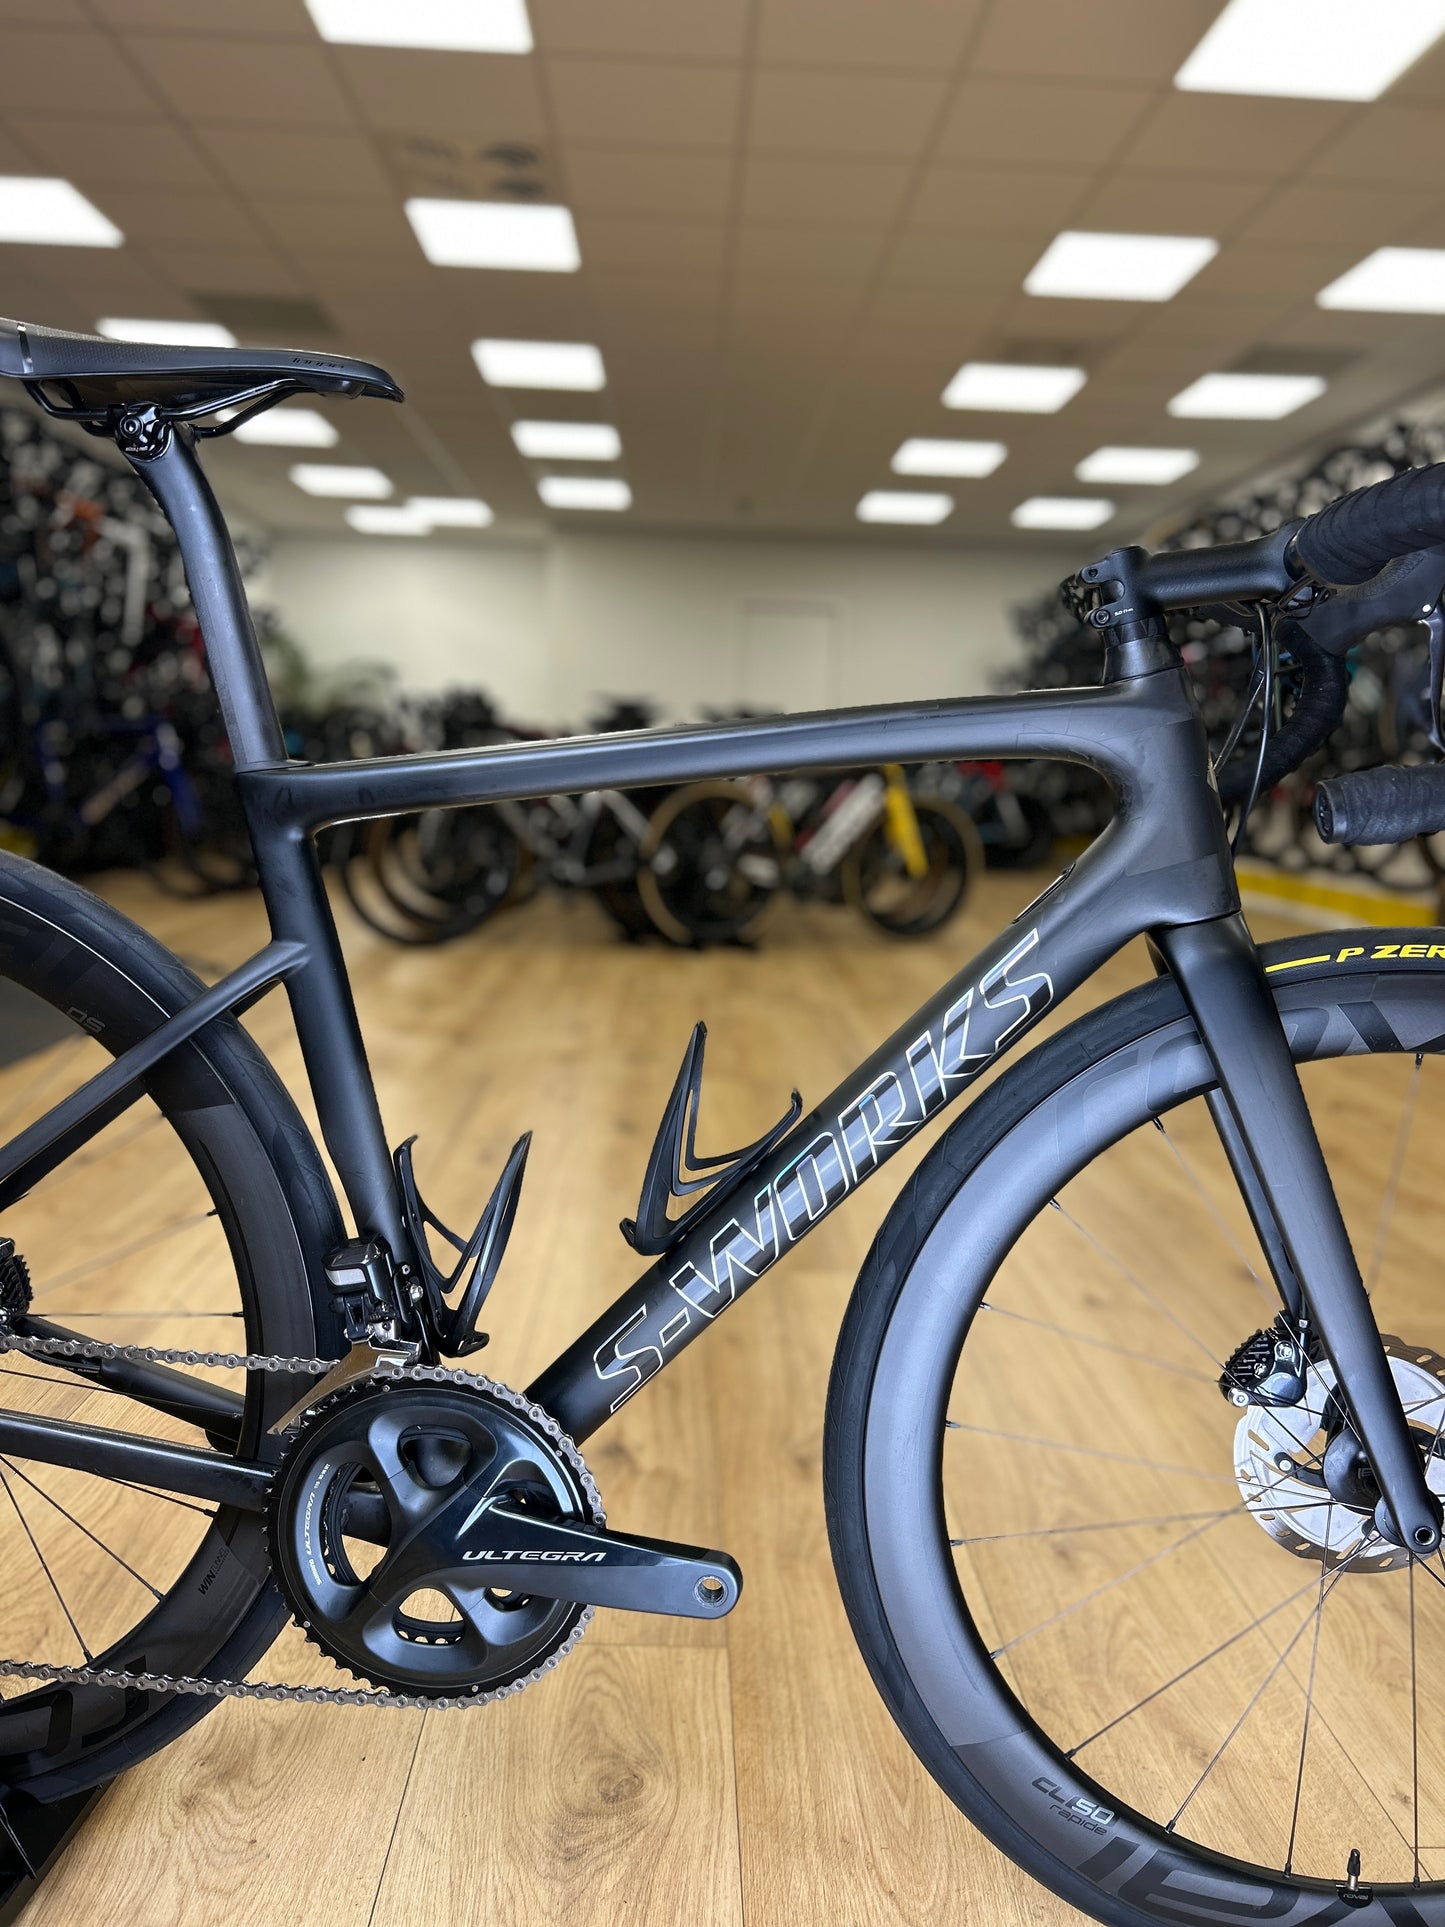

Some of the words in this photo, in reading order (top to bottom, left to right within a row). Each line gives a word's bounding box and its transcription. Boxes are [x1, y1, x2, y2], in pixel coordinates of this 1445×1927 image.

[1336, 946, 1365, 963] P
[1370, 944, 1445, 959] ZER
[593, 927, 1054, 1413] S-WORKS
[304, 1491, 316, 1556] ULTEGRA
[462, 1550, 607, 1562] ULTEGRA
[1049, 1804, 1108, 1836] rapide
[1071, 1798, 1115, 1825] 50
